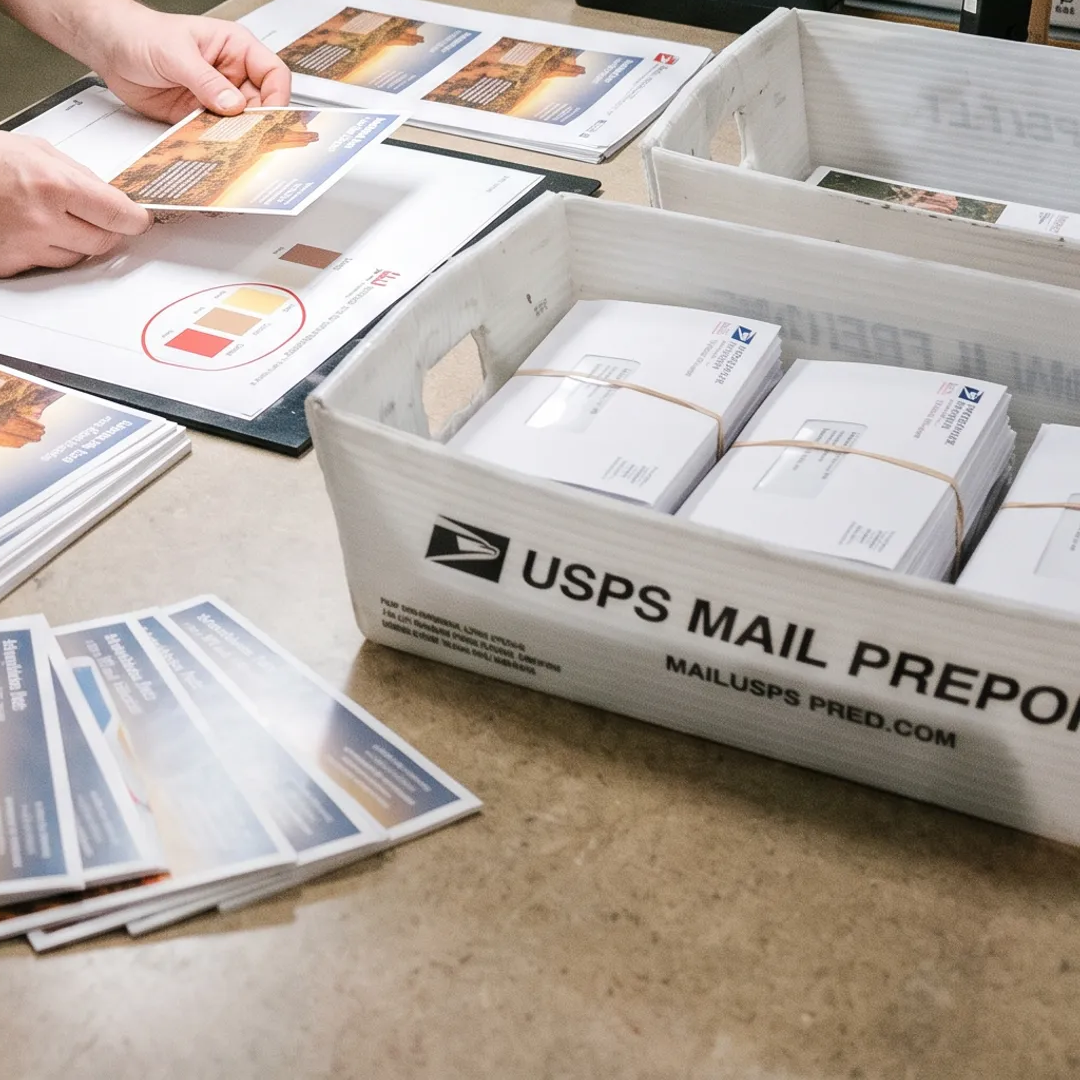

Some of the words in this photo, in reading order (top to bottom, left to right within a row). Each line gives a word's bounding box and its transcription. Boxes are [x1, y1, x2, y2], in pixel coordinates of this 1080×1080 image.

[522, 550, 670, 622] USPS
[688, 599, 827, 668] MAIL
[848, 640, 1080, 732] PREPO
[666, 654, 800, 707] MAILUSPS
[809, 696, 956, 749] PRED.COM
